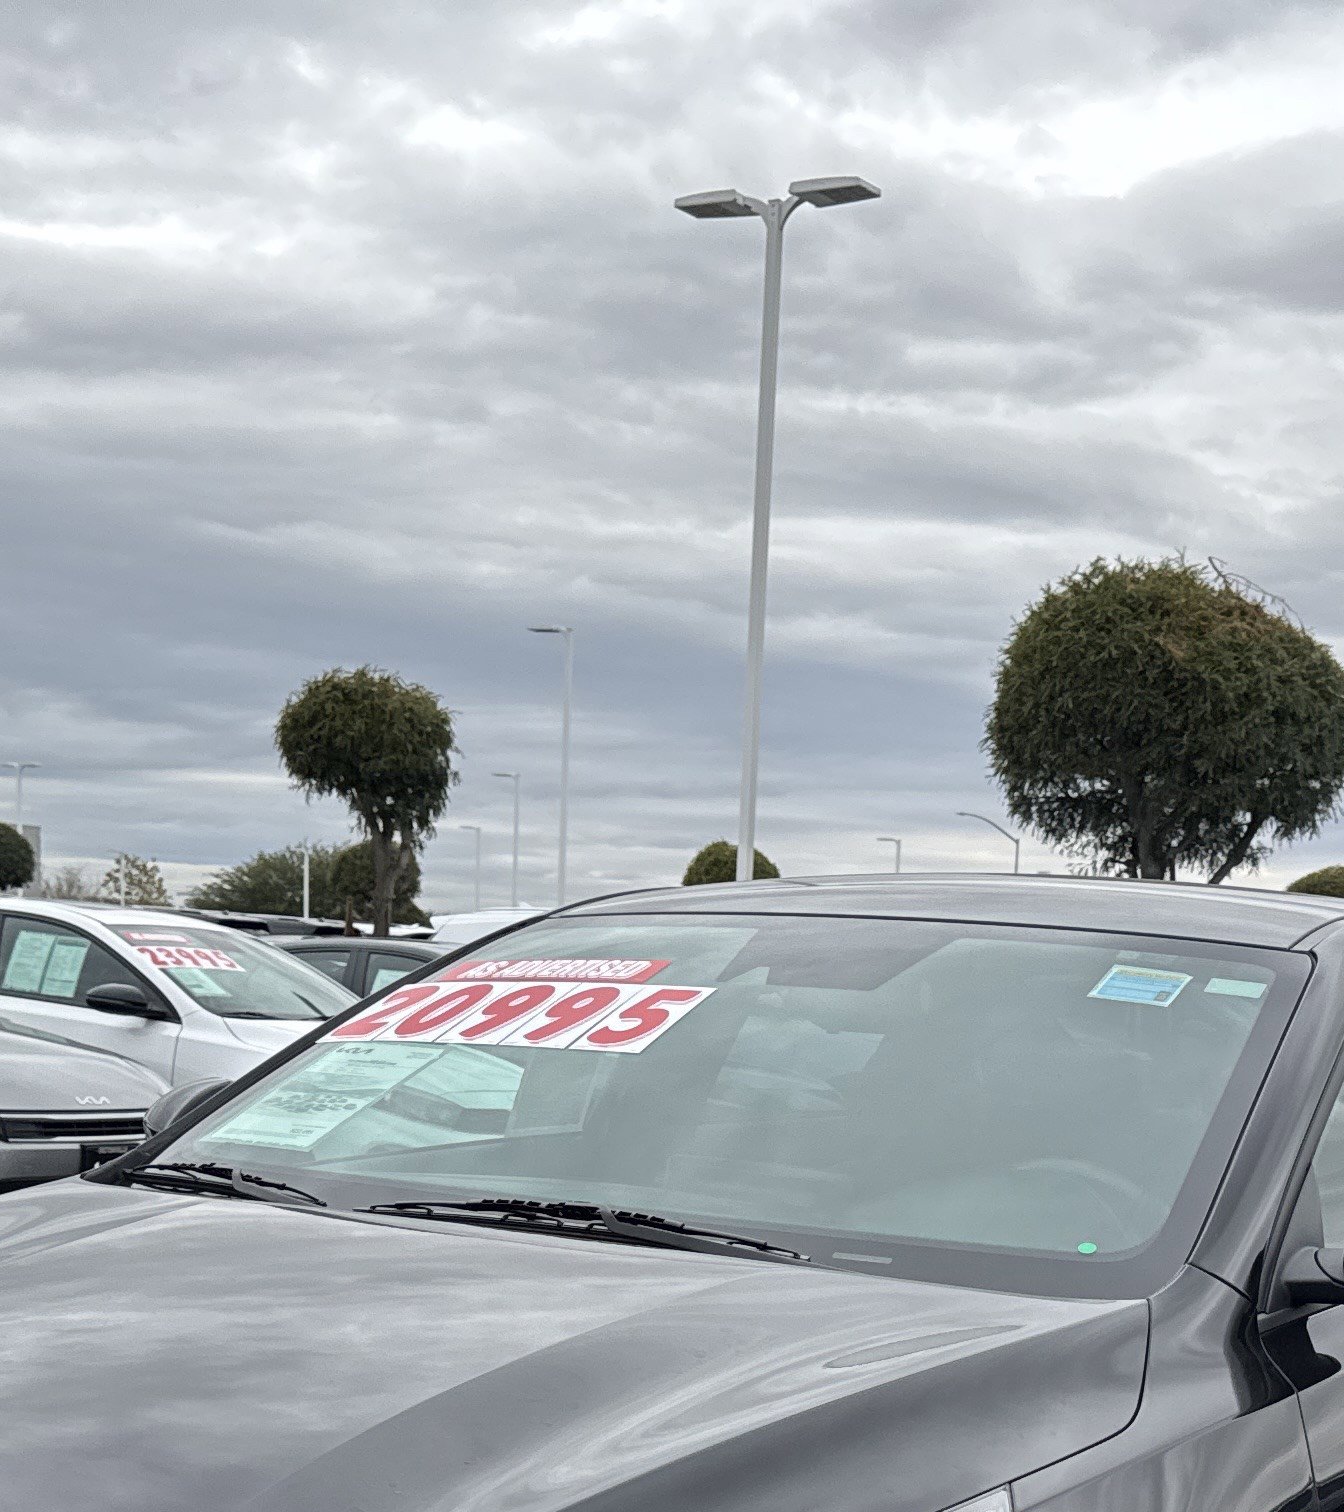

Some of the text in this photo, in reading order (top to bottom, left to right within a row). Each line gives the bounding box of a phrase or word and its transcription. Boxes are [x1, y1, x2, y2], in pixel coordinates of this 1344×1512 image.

[137, 947, 237, 969] 23995
[457, 960, 652, 980] AS ADVERTISED
[332, 984, 702, 1047] 20995
